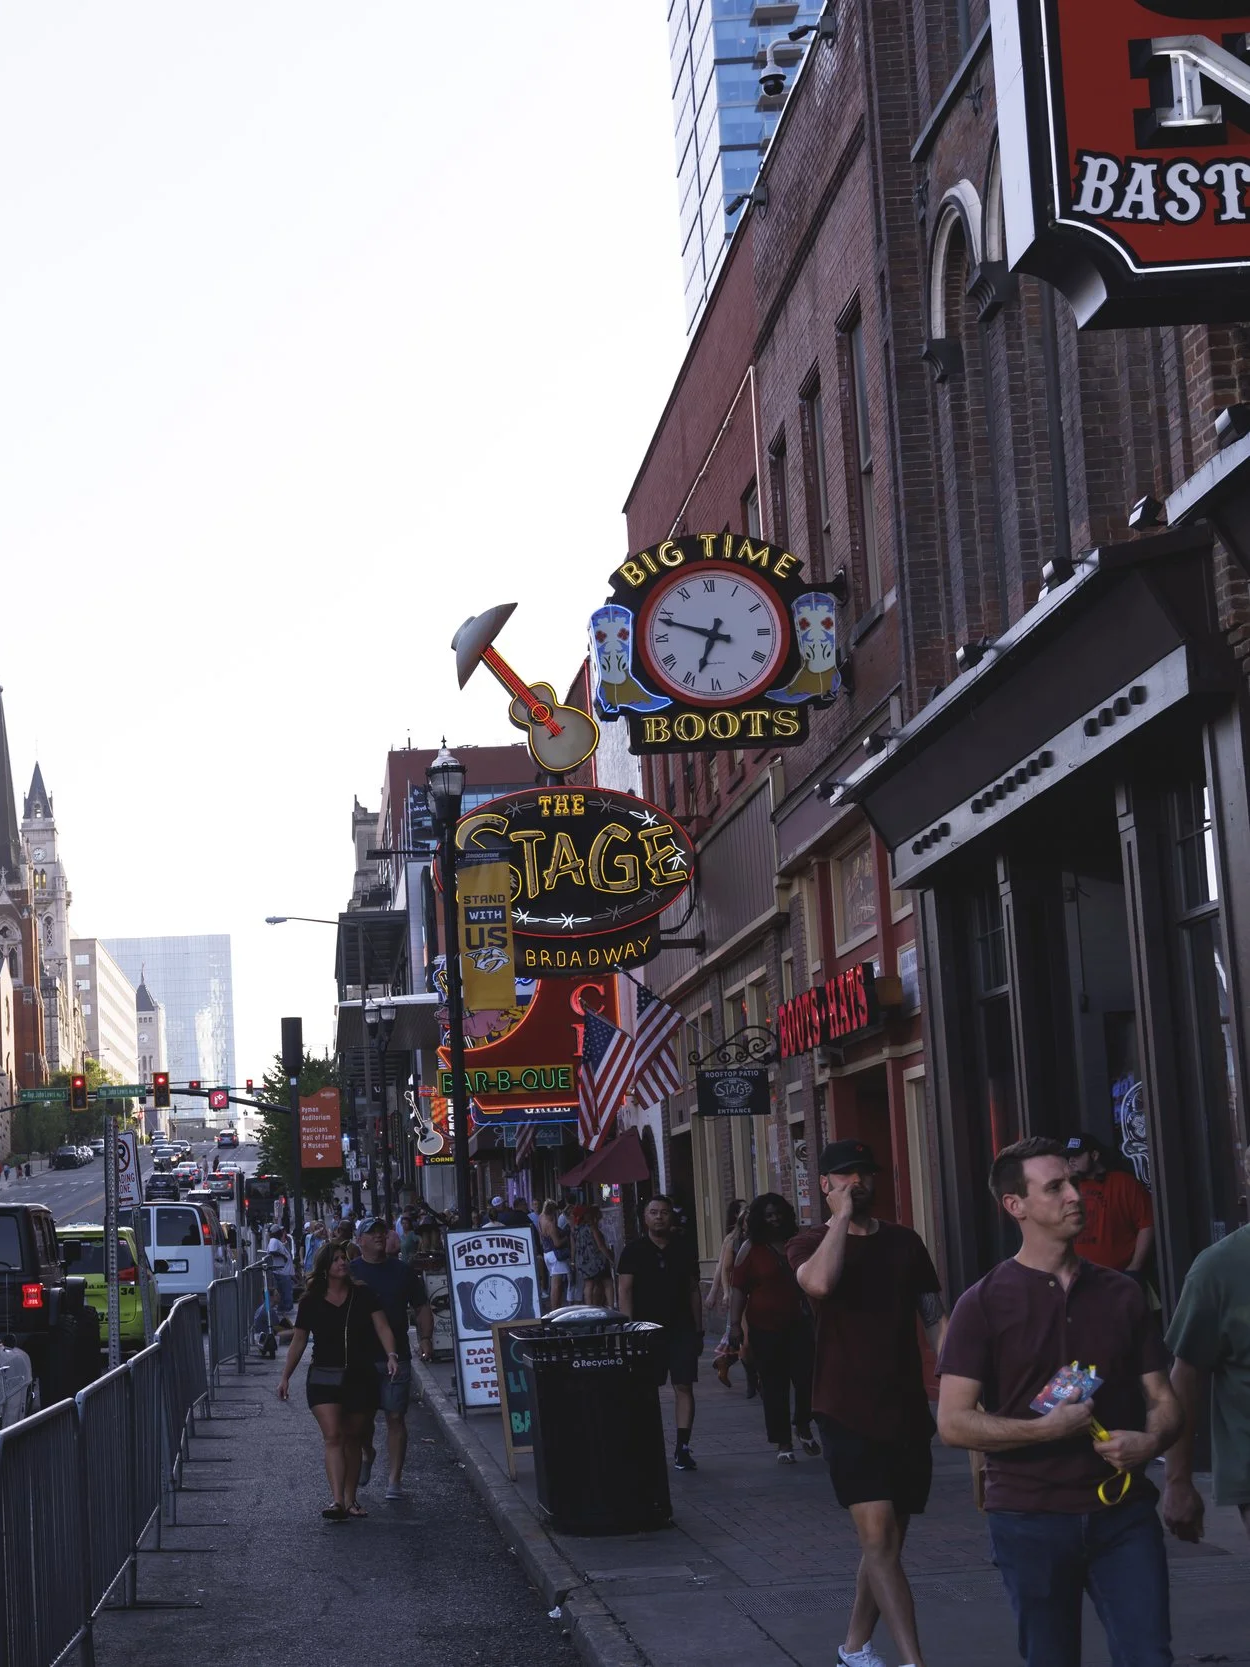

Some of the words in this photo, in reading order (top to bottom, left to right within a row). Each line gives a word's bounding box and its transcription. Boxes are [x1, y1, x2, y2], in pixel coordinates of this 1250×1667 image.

[620, 540, 686, 588] BIG
[698, 533, 799, 580] TIME
[642, 708, 802, 745] BOOTS
[539, 795, 586, 816] THE
[463, 894, 506, 905] STAND
[469, 910, 502, 920] WITH
[465, 926, 509, 950] US
[525, 936, 651, 967] BROADWAY
[777, 987, 821, 1060] BOOTS
[825, 963, 868, 1040] HATS
[119, 1183, 131, 1194] ONE
[457, 1239, 482, 1258] BIG
[486, 1237, 525, 1254] TIME
[464, 1252, 520, 1267] BOOTS
[120, 1287, 135, 1295] 34
[581, 1358, 615, 1367] Recycle
